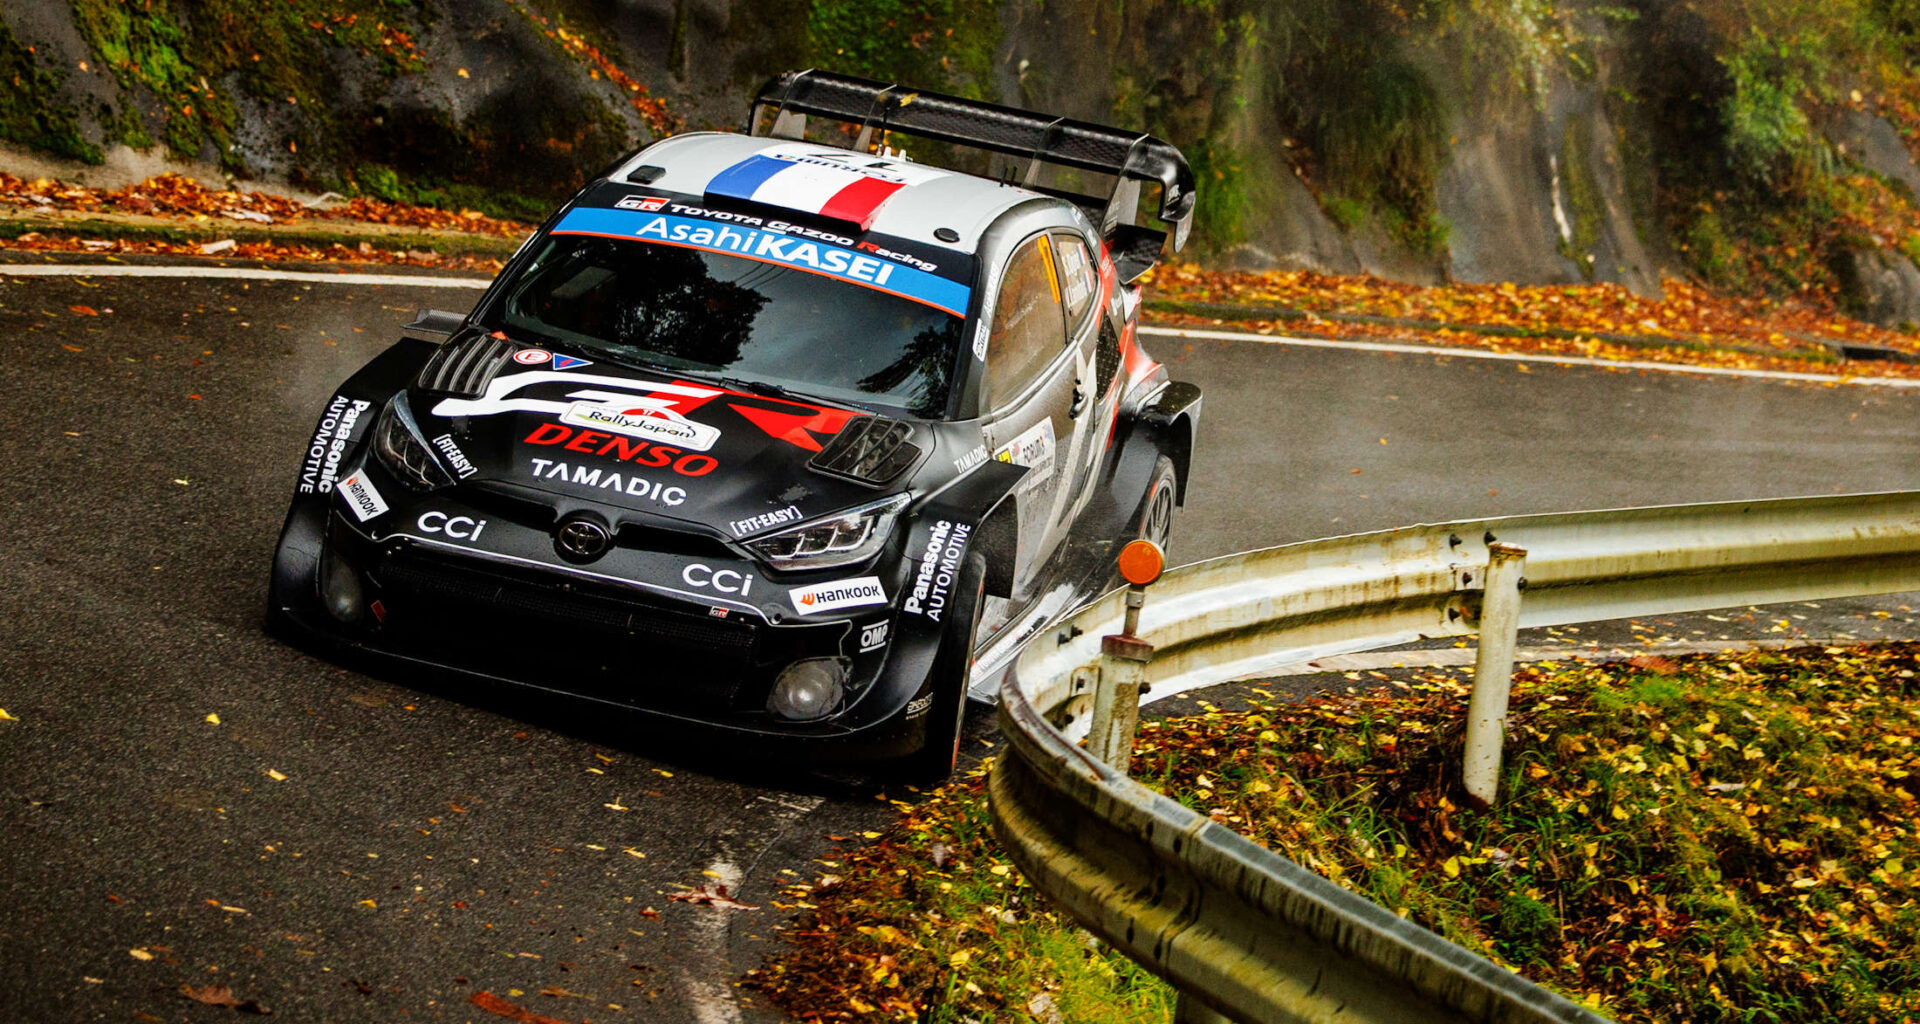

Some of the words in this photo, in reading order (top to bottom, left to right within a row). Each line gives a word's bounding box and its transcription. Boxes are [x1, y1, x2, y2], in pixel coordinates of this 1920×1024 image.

[618, 198, 664, 210] GR
[670, 203, 763, 226] TOYOTA
[766, 219, 855, 248] GAZOO
[856, 240, 939, 273] Racing
[300, 395, 349, 494] AUTOMOTIVE
[318, 399, 371, 494] Panasonic
[523, 422, 719, 477] DENSO
[953, 444, 989, 474] TAMADIC
[531, 458, 687, 506] TAMADIC
[417, 511, 487, 542] CCi
[682, 563, 754, 597] CCi
[904, 519, 952, 615] Panasonic
[926, 522, 971, 622] AUTOMOTIVE
[860, 624, 889, 648] OMP
